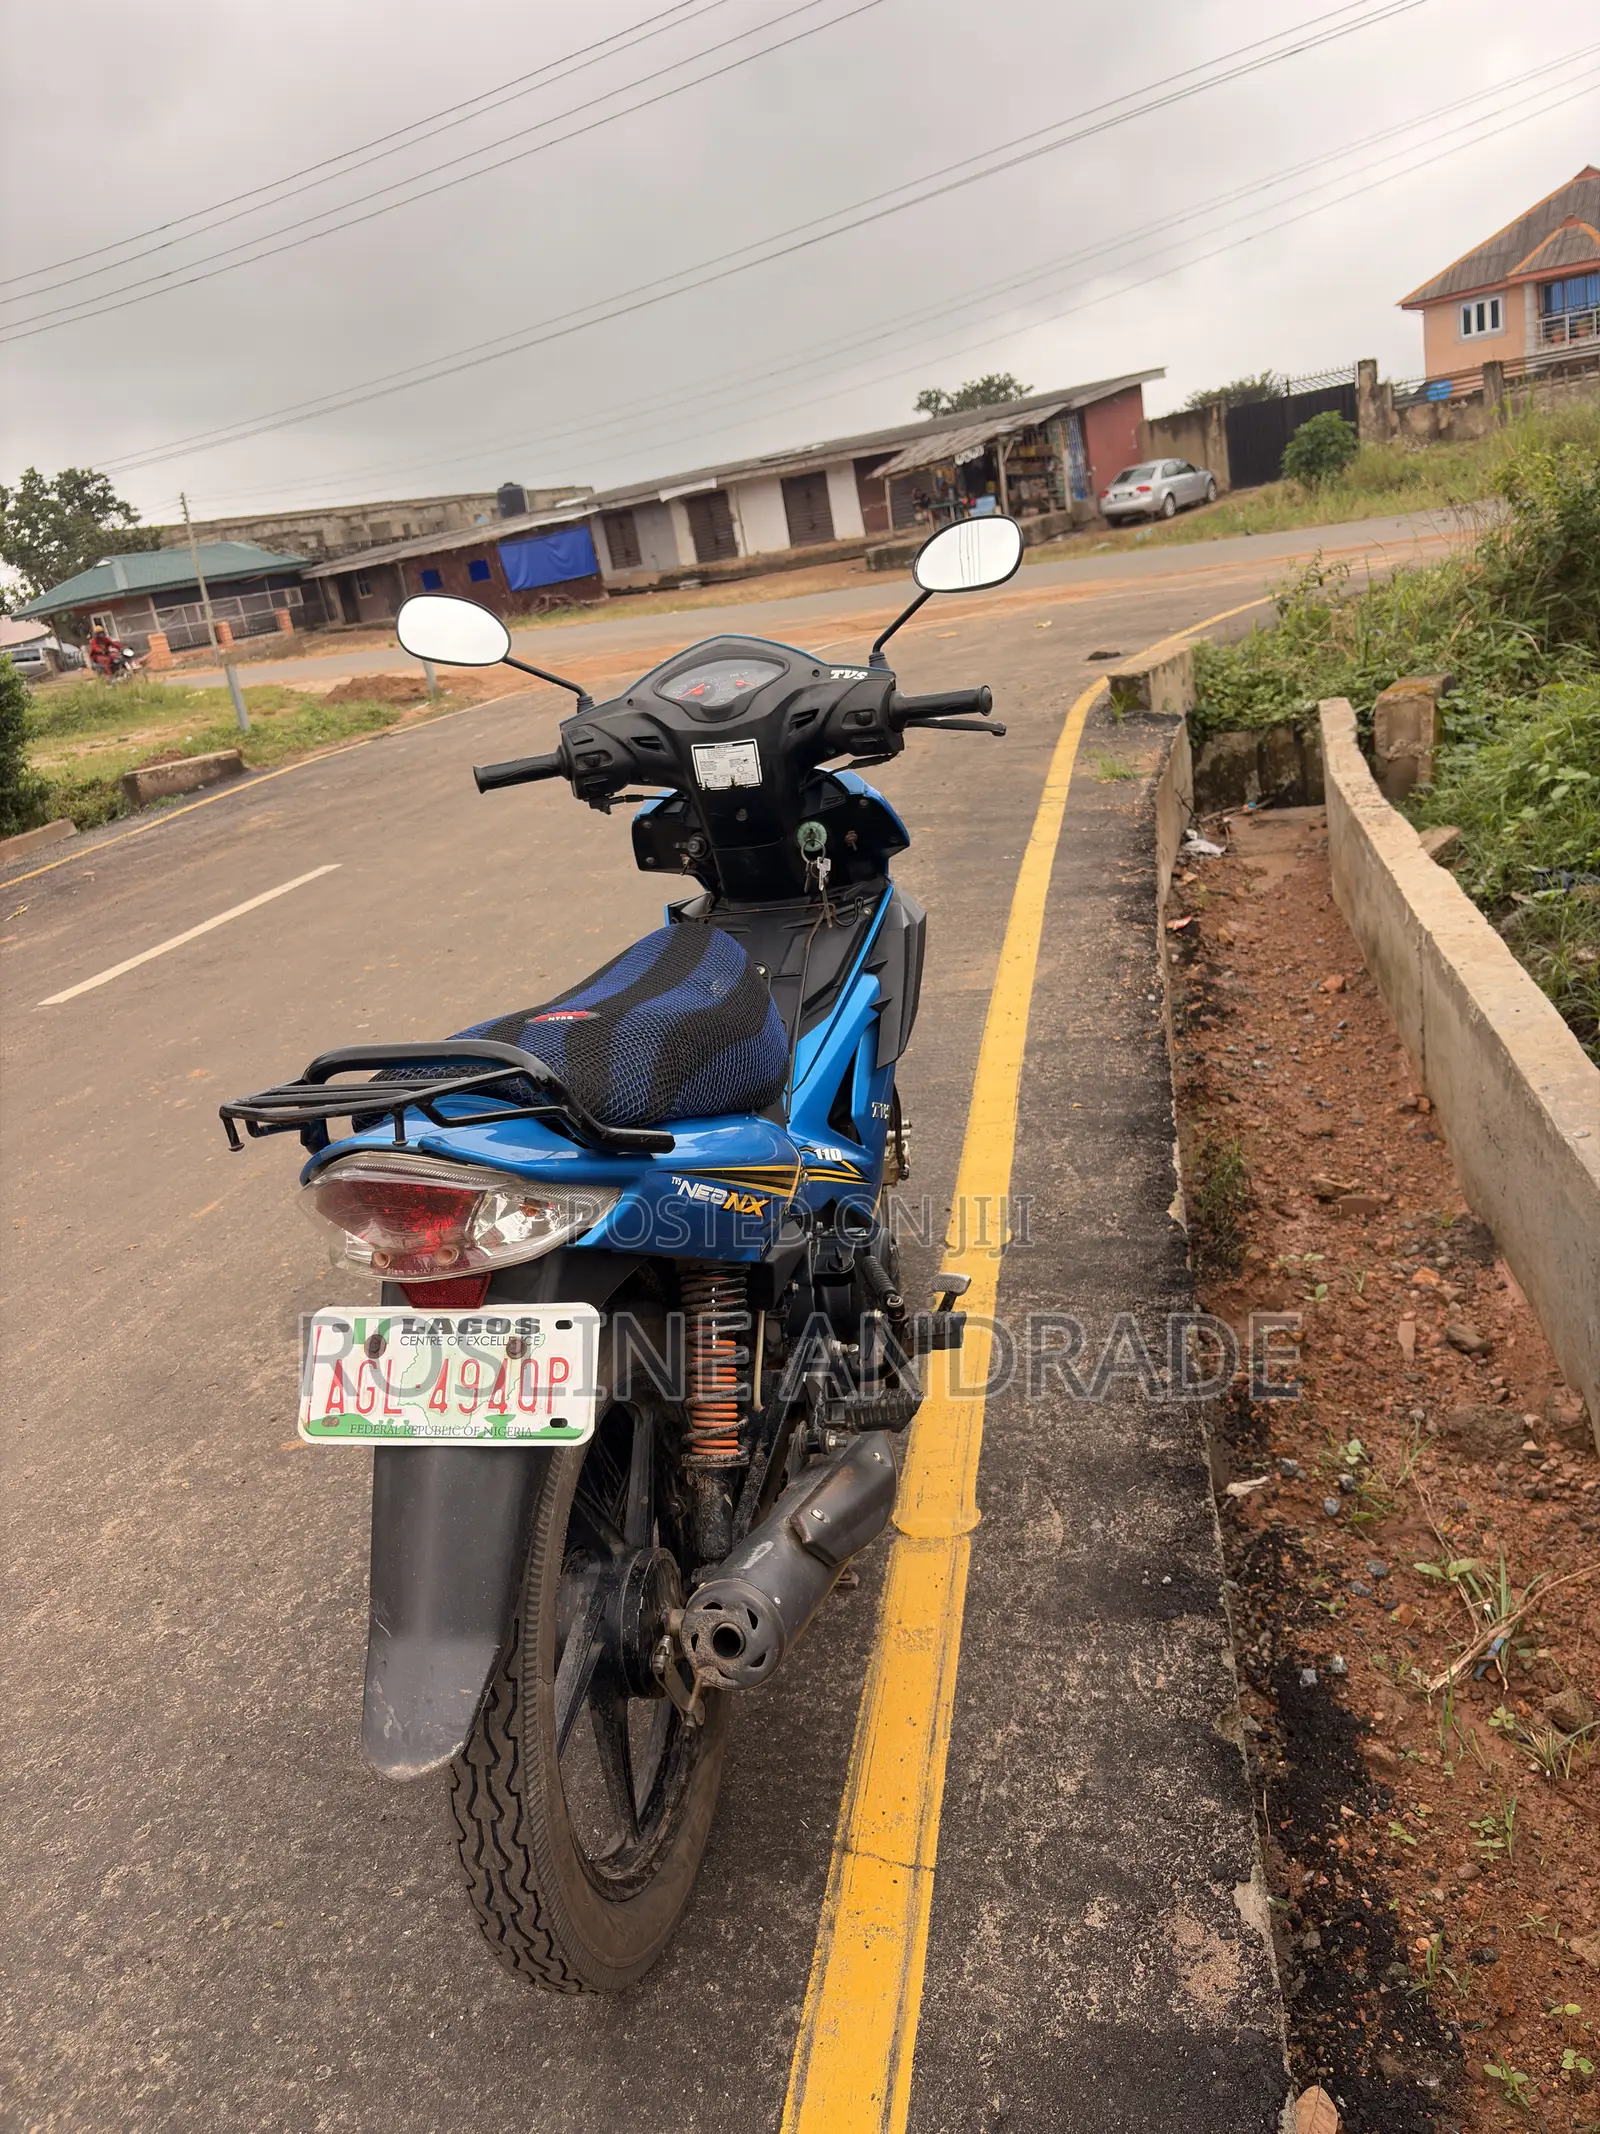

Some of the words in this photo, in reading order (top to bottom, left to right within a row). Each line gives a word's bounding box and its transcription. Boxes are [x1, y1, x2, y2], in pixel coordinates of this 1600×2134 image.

[830, 669, 869, 680] TVS
[813, 1148, 843, 1162] 110
[671, 1176, 683, 1186] TVS
[400, 1317, 541, 1335] LAGOS
[400, 1336, 443, 1346] CENTRE
[446, 1336, 464, 1346] OF
[466, 1336, 541, 1347] EXCELLCE
[325, 1358, 403, 1415] AGL
[350, 1424, 401, 1436] FEDERAL
[402, 1425, 461, 1437] REPUBLIC
[463, 1426, 481, 1437] OF
[482, 1427, 533, 1438] NIGERIA
